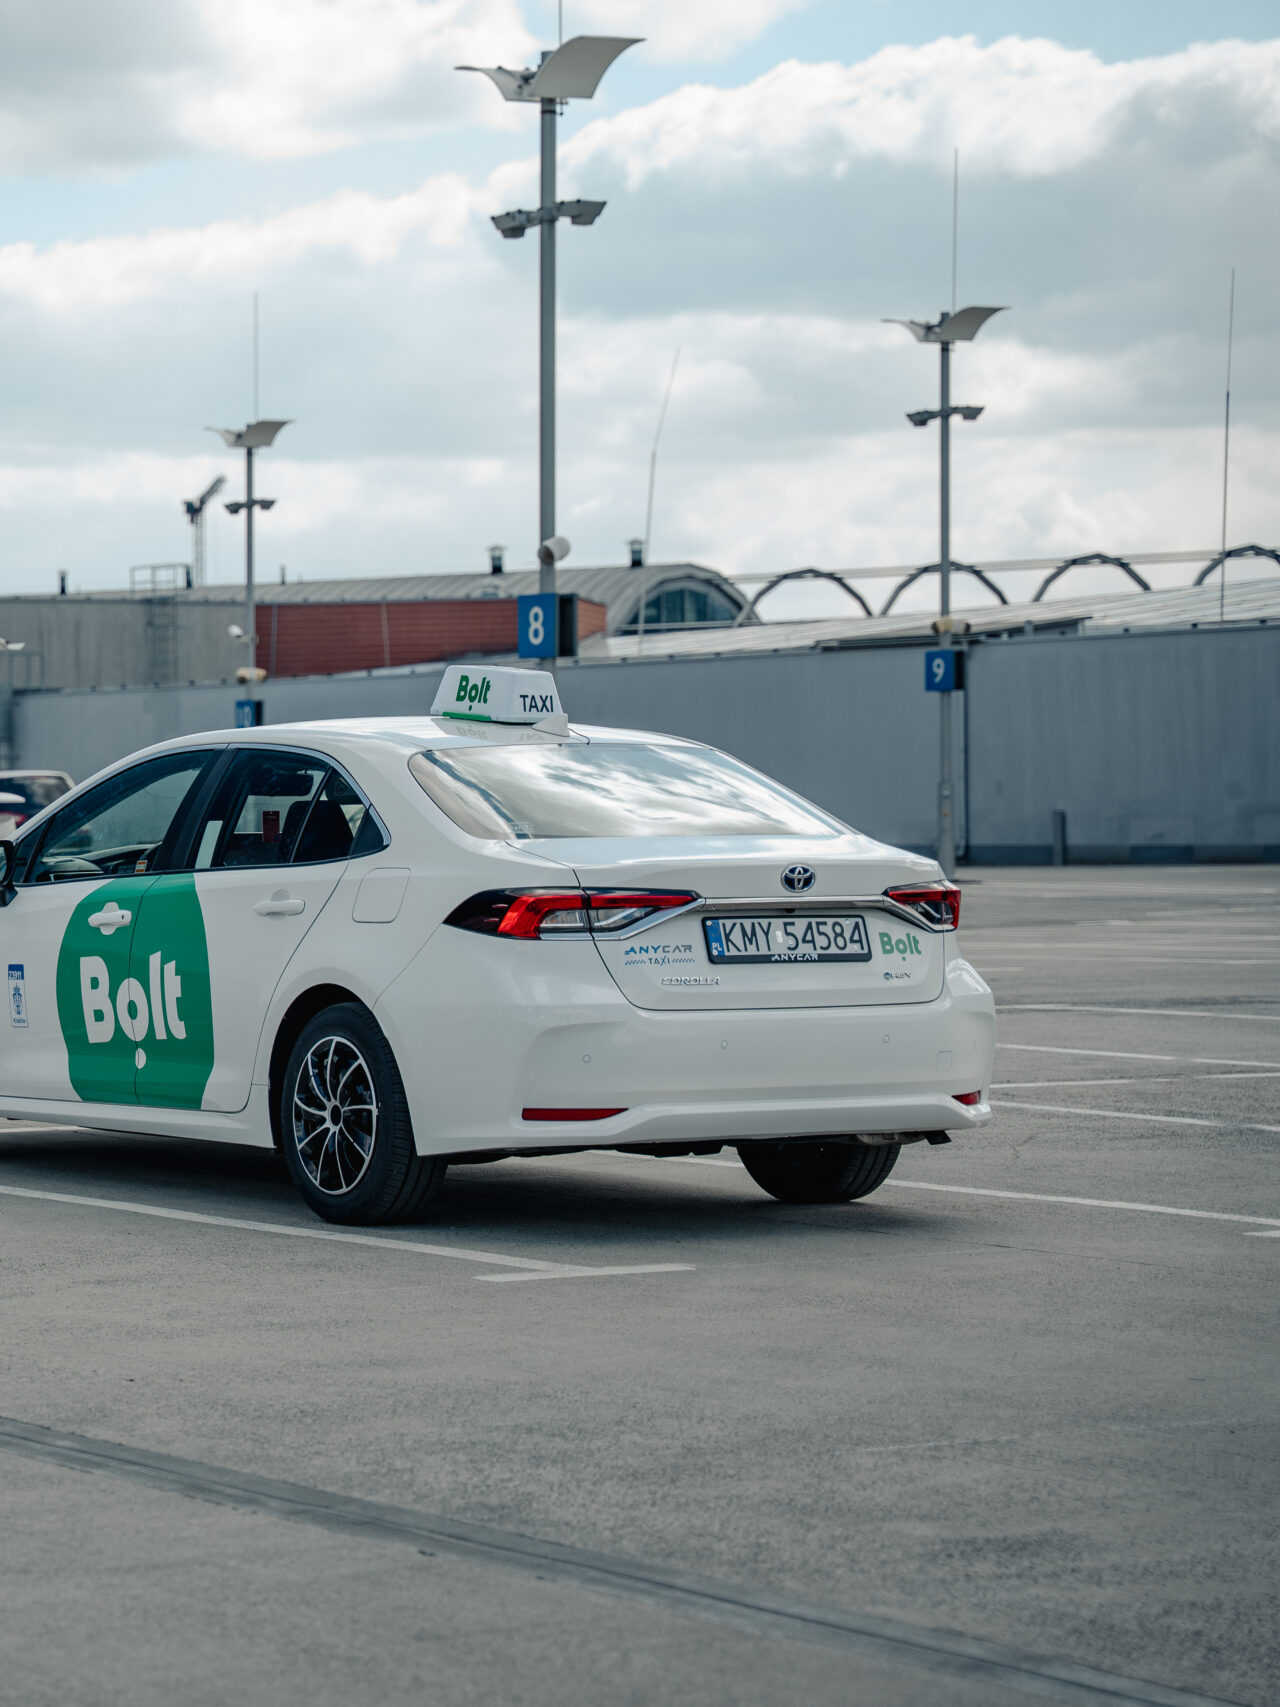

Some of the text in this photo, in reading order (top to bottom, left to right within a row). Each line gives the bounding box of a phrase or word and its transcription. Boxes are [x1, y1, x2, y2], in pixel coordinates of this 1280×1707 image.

[527, 605, 545, 646] 8
[932, 657, 945, 683] 9
[455, 674, 491, 712] Bolt
[519, 694, 554, 713] TAXI
[712, 942, 723, 951] PL
[722, 920, 866, 953] KMY 54584
[878, 931, 922, 962] Bolt
[624, 944, 693, 956] ANYCAR
[647, 955, 671, 967] TAXI
[771, 953, 819, 961] ANYCAR
[79, 950, 187, 1070] Bolt
